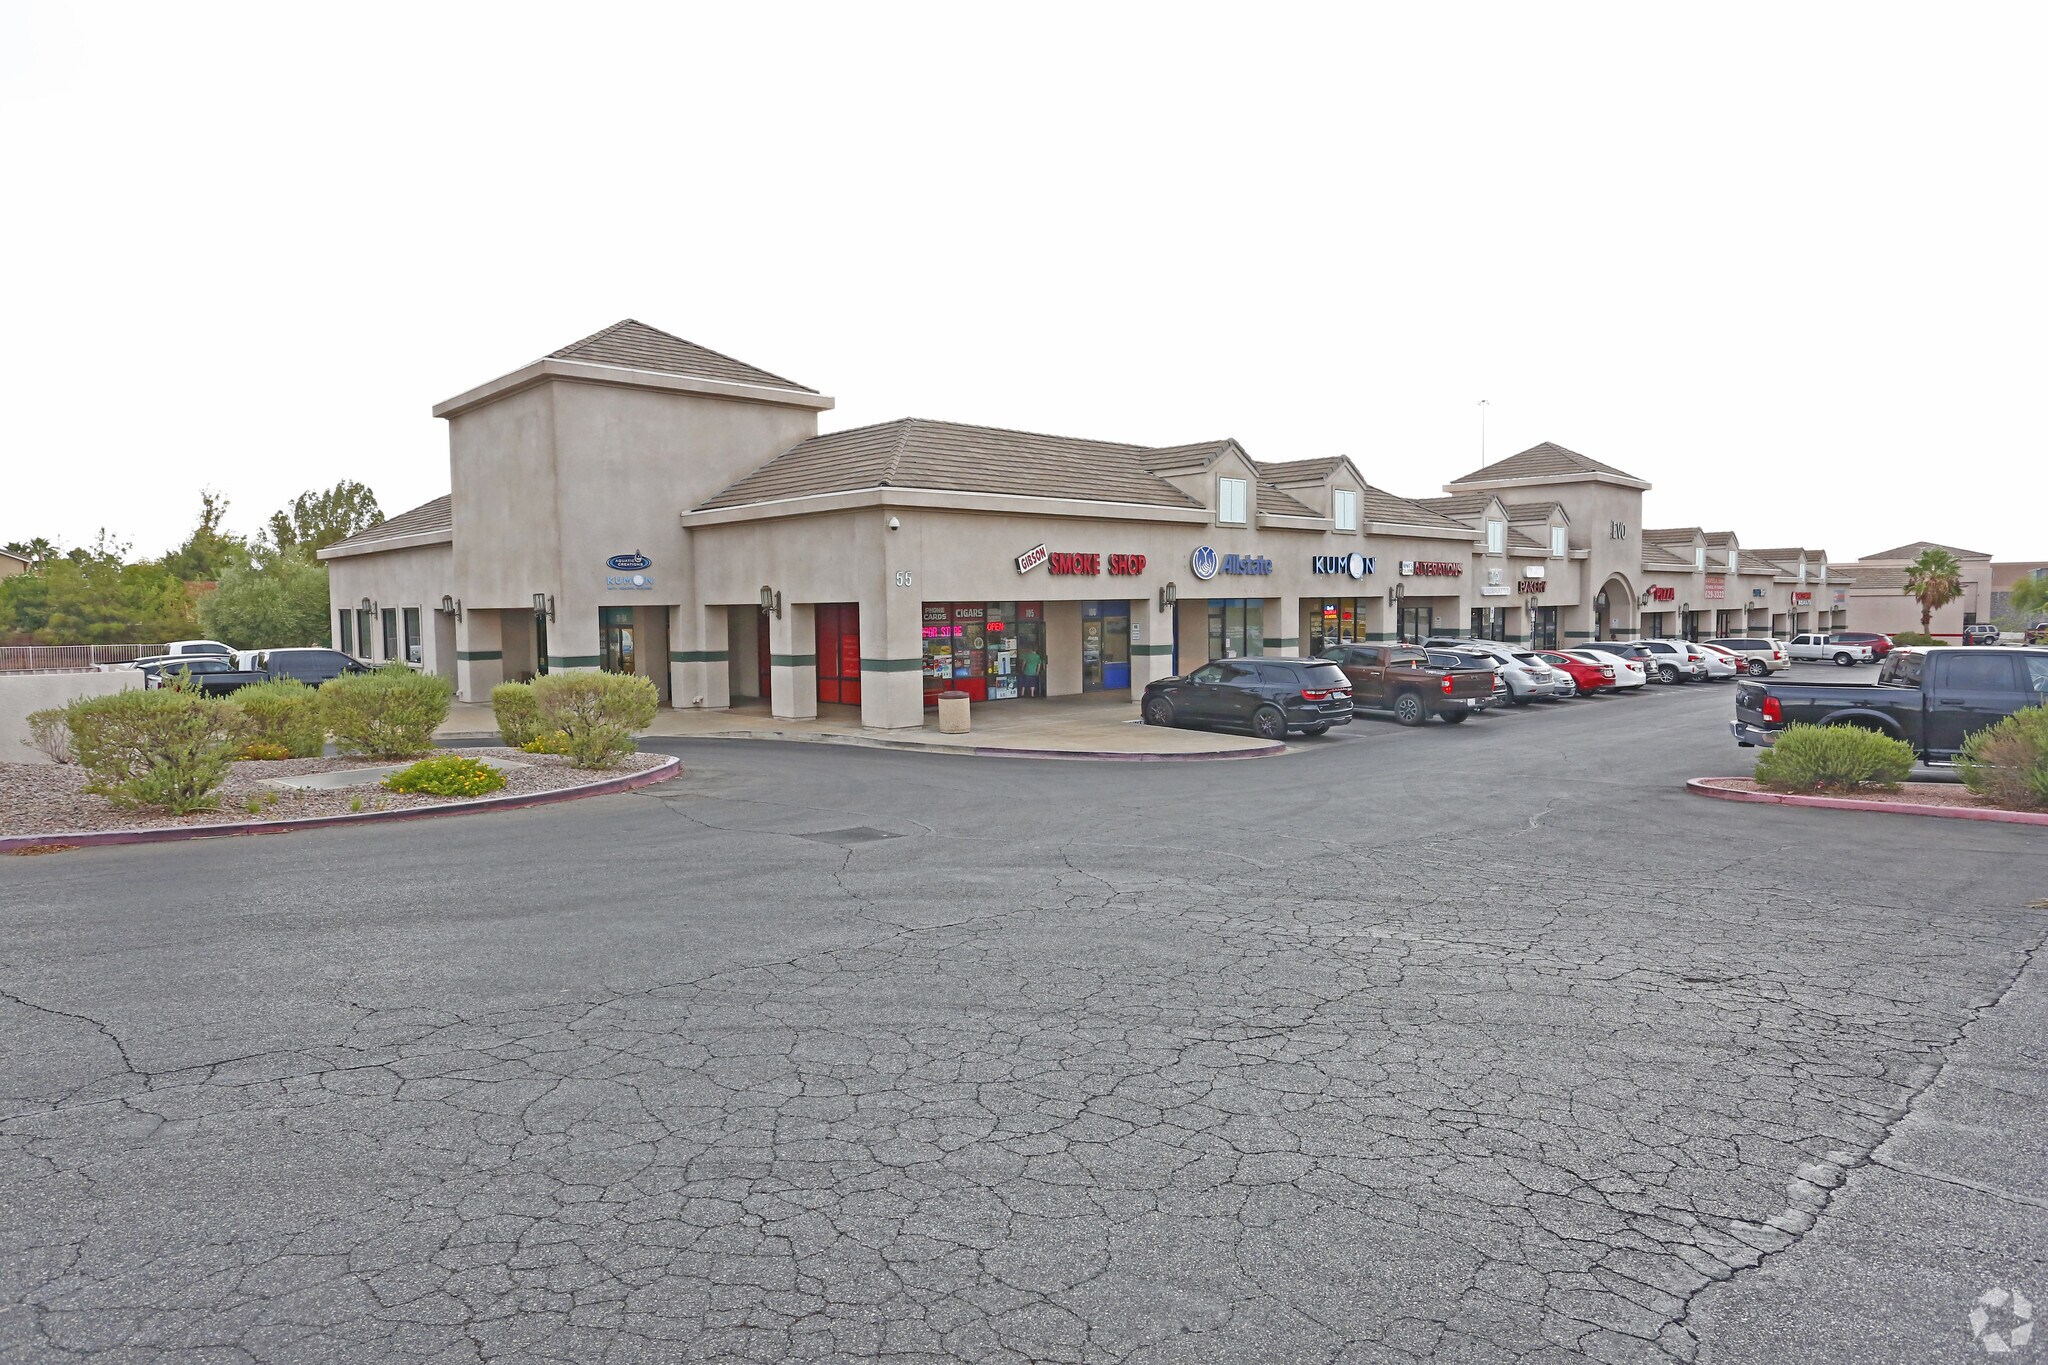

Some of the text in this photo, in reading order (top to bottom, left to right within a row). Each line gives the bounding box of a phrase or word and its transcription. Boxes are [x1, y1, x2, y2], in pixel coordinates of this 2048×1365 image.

[1020, 547, 1046, 570] GIBSON
[1048, 552, 1146, 575] SMOKE SHOP
[1219, 554, 1273, 575] Allstate
[1313, 552, 1376, 579] KUMON
[1414, 561, 1463, 577] ALTERATIONS
[607, 575, 653, 585] KUMON
[896, 571, 912, 587] 55
[1654, 587, 1674, 601] PIZZA
[955, 608, 983, 617] CIGARS
[986, 622, 1004, 631] OPEN
